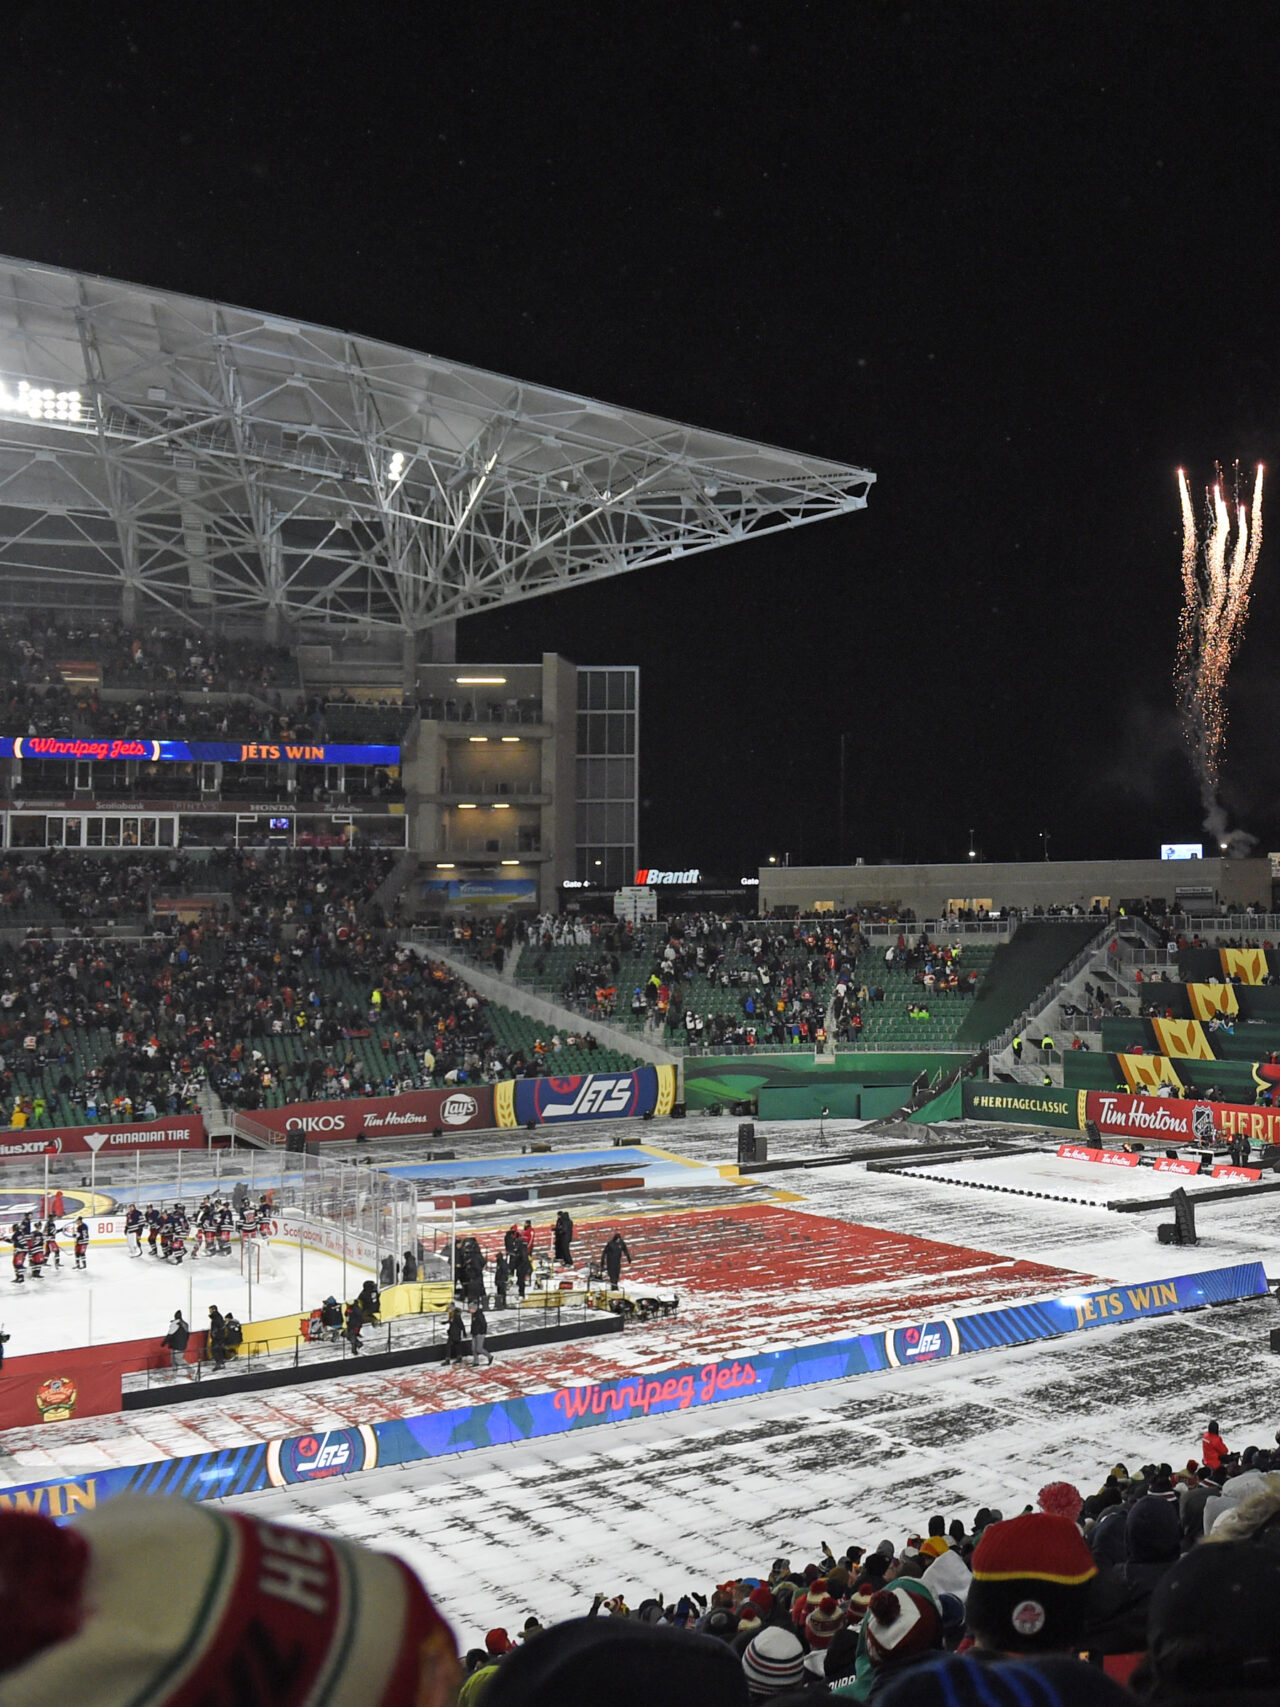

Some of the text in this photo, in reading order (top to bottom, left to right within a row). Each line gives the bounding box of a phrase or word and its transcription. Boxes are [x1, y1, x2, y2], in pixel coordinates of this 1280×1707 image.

[29, 738, 145, 759] Winnipeg Jets
[241, 744, 324, 761] JETS WIN
[250, 804, 296, 812] HONDA
[563, 880, 590, 888] Gate 4
[646, 869, 700, 884] Brandt
[741, 877, 759, 886] Gate
[541, 1074, 632, 1116] JETS
[973, 1096, 1069, 1114] #HERITAGECLASSIC
[286, 1115, 346, 1131] OIKOS
[363, 1112, 428, 1127] Tim Hortons
[1100, 1098, 1127, 1125] Tim
[1128, 1099, 1187, 1133] Hortons
[110, 1129, 190, 1144] CANADIAN TIRE
[1062, 1148, 1090, 1161] Tim Hortons
[1102, 1153, 1131, 1166] Tim Hortons
[1159, 1161, 1191, 1174] Tim Hortons
[98, 1223, 113, 1233] 80
[283, 1223, 322, 1243] Scotabank
[1075, 1282, 1178, 1329] JETS WIN
[906, 1323, 941, 1356] JETS
[554, 1361, 757, 1419] Winnipeg Jets
[296, 1431, 349, 1471] JETS
[0, 1478, 96, 1517] WIN
